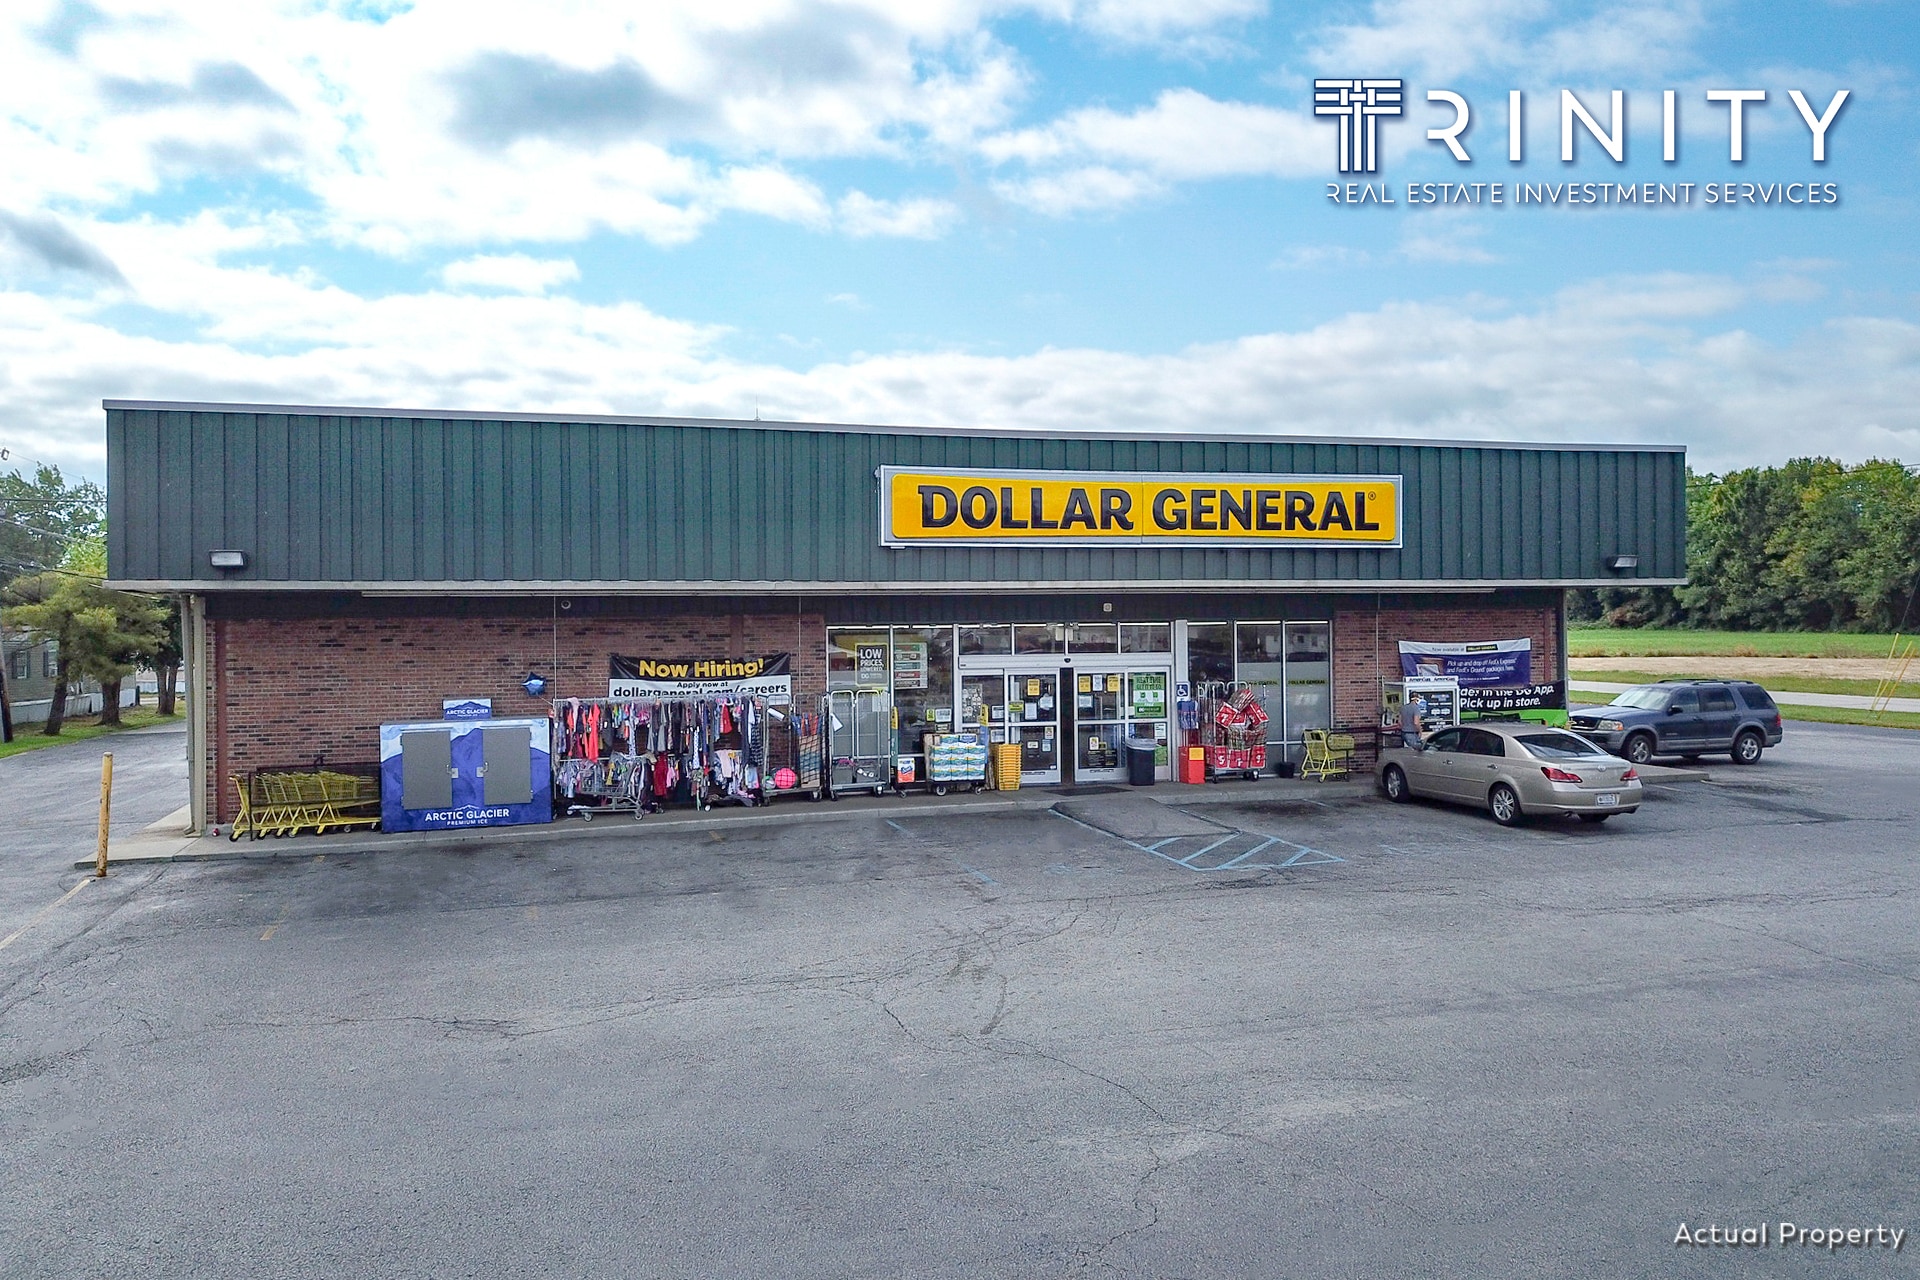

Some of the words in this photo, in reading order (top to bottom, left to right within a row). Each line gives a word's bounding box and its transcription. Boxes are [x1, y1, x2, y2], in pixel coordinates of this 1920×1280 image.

[917, 485, 1134, 530] DOLLAR
[860, 648, 882, 659] LOW
[639, 660, 689, 678] Now
[694, 658, 764, 678] Hiring!
[613, 684, 787, 699] dollargeneralcom/careers
[1533, 685, 1555, 696] App.
[1460, 697, 1484, 708] Pick
[1486, 699, 1501, 710] up
[1503, 697, 1513, 708] in
[1515, 696, 1541, 707] store.
[425, 811, 464, 822] ARCTIC
[466, 808, 510, 820] GLACIER
